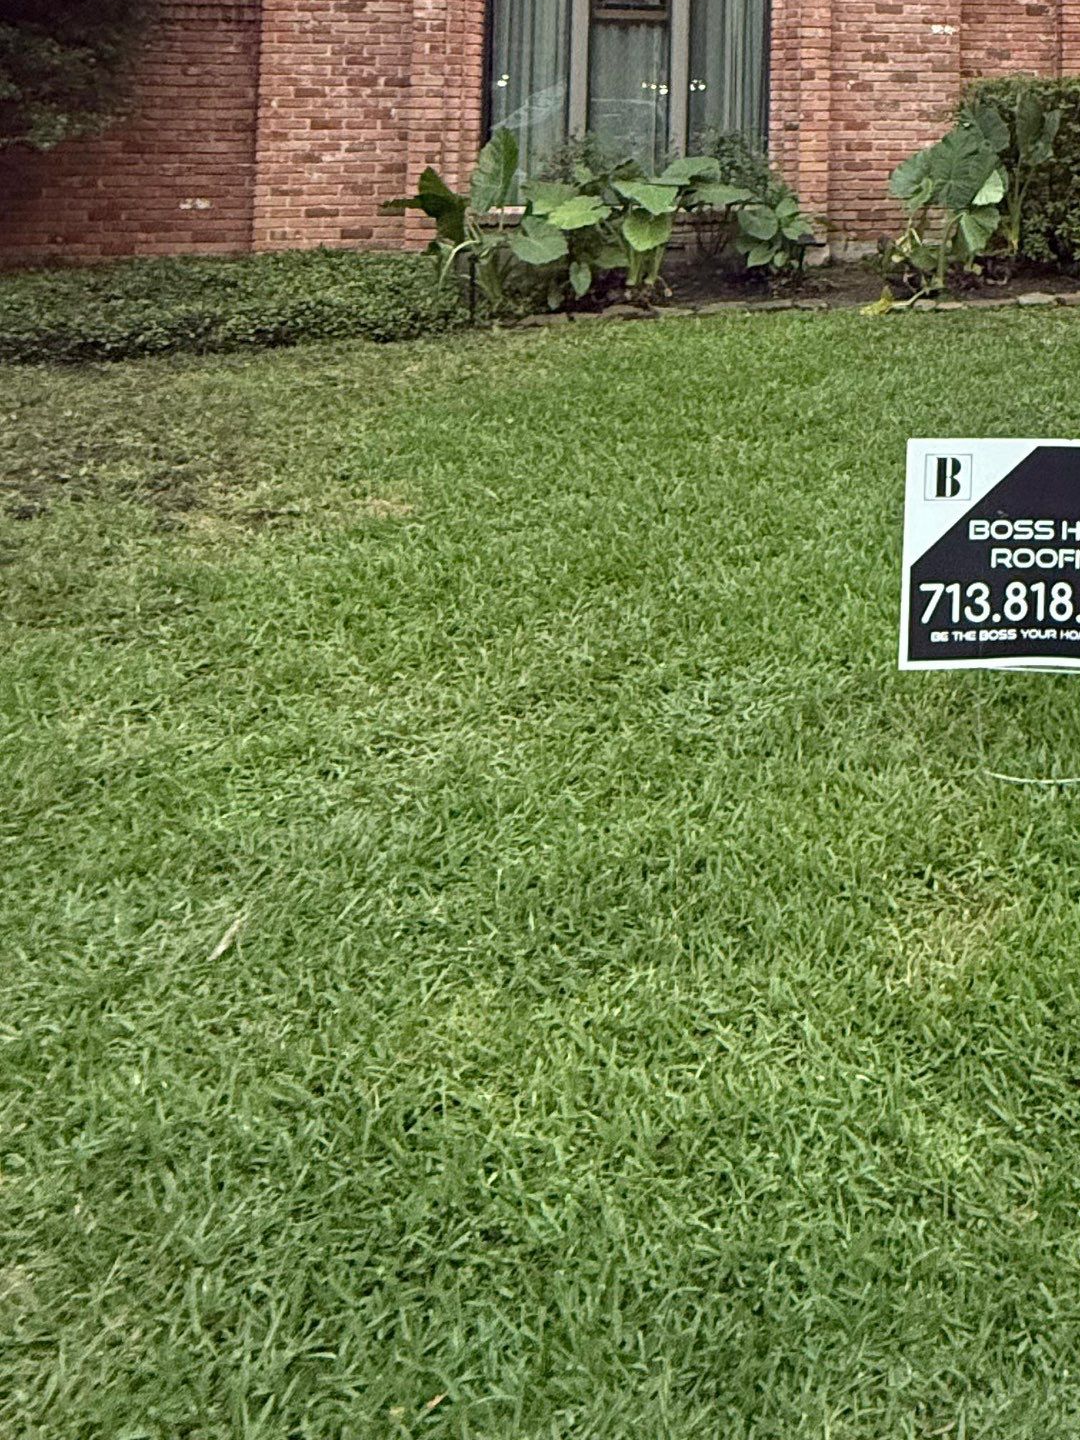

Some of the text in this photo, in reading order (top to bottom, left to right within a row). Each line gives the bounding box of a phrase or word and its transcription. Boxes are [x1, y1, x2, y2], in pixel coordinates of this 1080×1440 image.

[936, 457, 961, 497] B
[969, 519, 1054, 540] BOSS
[930, 631, 949, 643] BE
[951, 630, 976, 642] THE
[979, 629, 1017, 641] BOSS
[1020, 629, 1057, 640] YOUR
